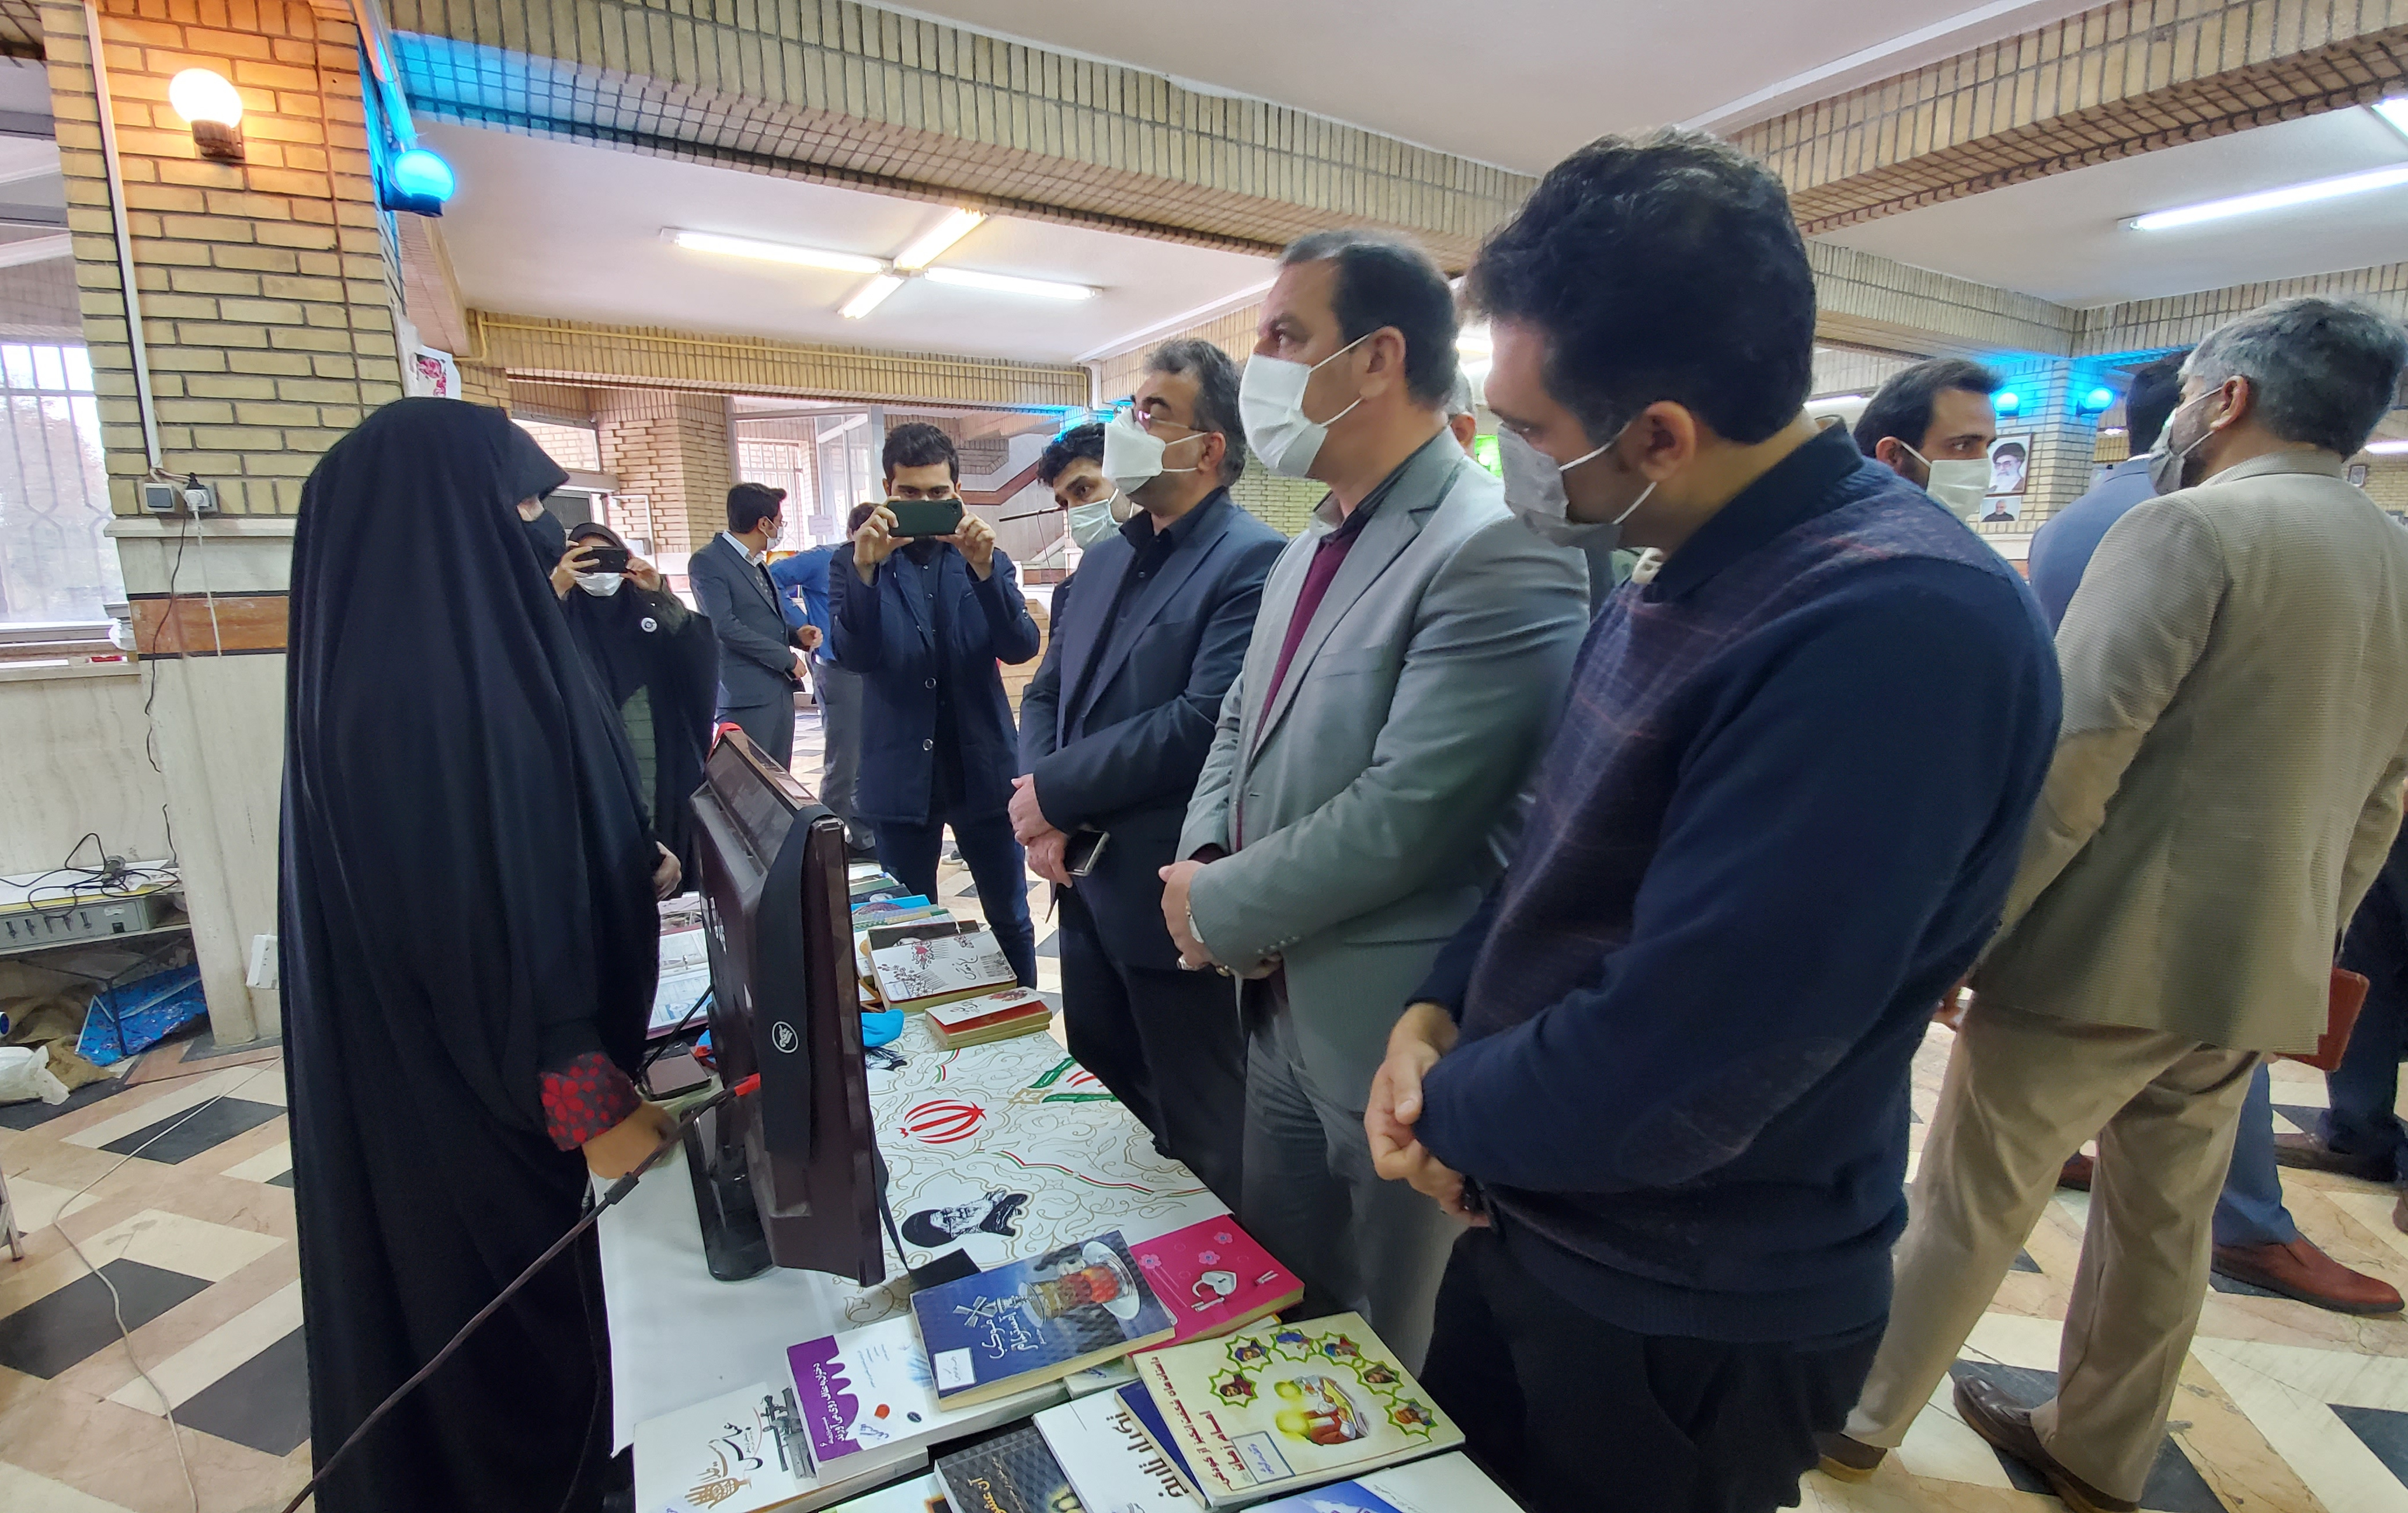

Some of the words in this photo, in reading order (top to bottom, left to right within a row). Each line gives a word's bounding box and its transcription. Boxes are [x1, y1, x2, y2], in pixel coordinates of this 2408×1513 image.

[827, 1400, 839, 1414] روی
[832, 1414, 843, 1424] می
[1199, 1410, 1230, 1442] امام
[1220, 1445, 1245, 1472] زمان
